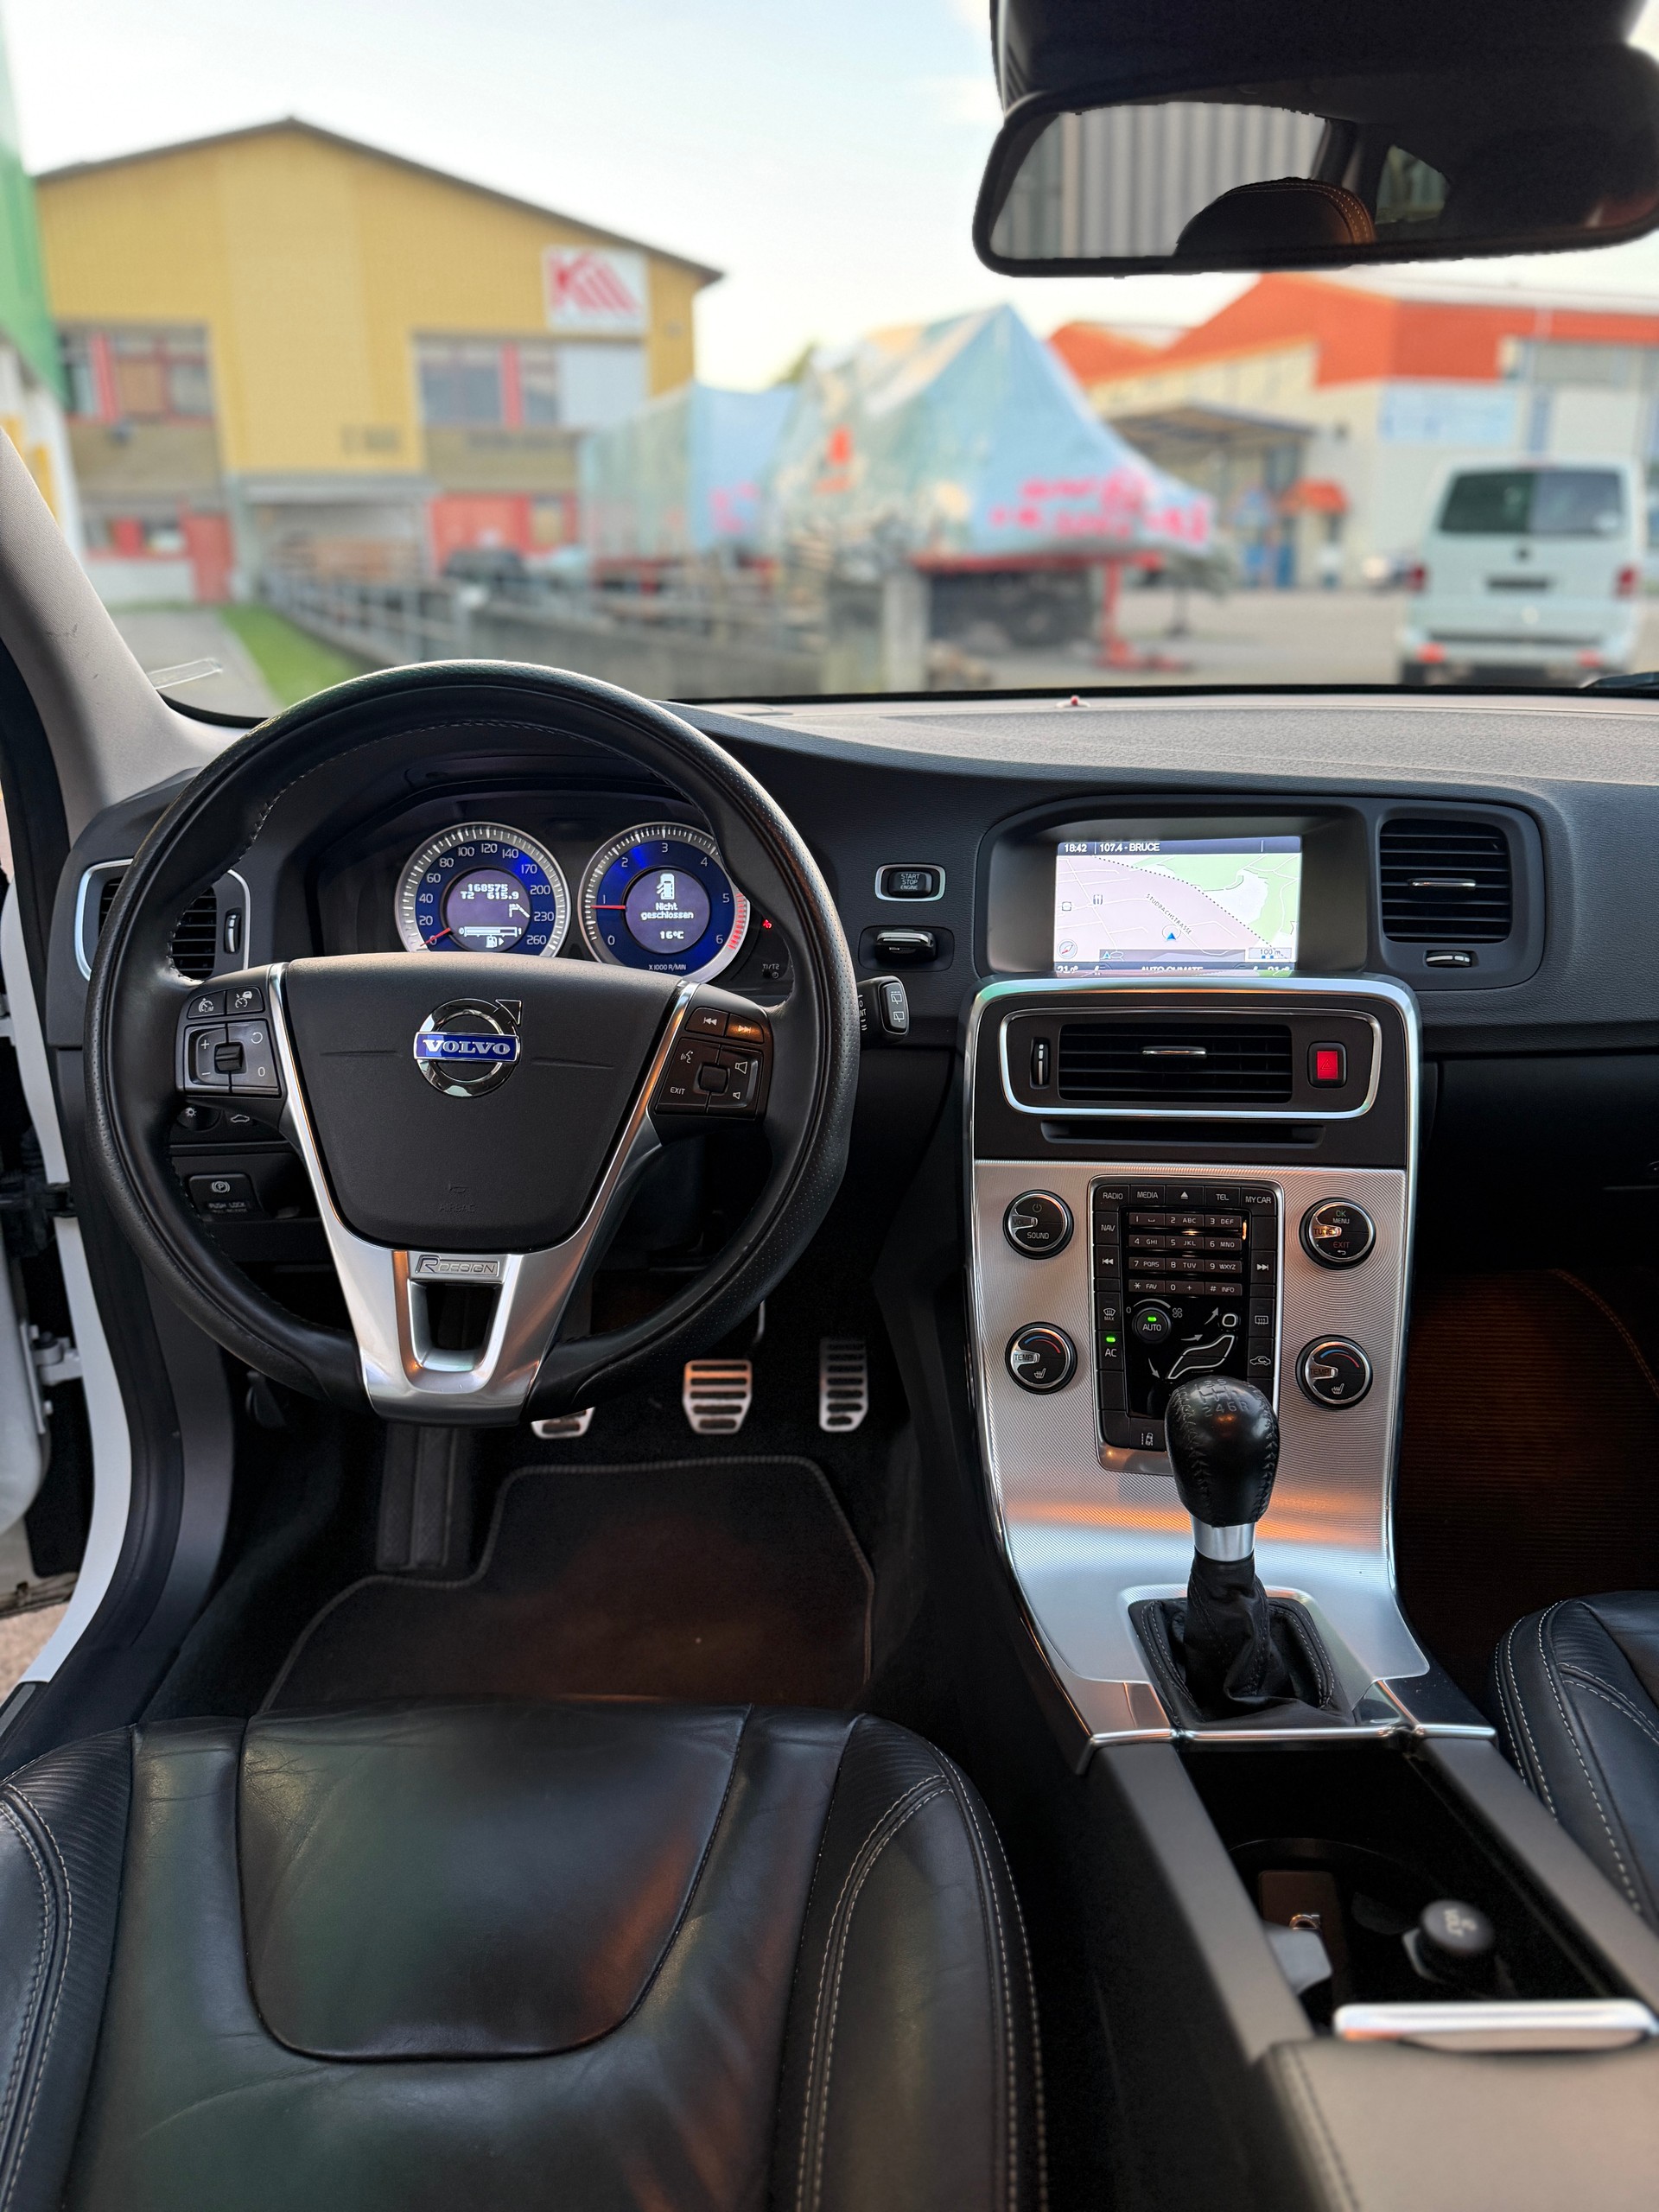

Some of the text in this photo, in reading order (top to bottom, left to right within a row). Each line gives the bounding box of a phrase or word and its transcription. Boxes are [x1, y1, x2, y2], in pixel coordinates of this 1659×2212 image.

[458, 847, 475, 857] 100
[481, 843, 498, 854] 120
[661, 842, 669, 853] 3
[1064, 843, 1088, 853] 18:42
[1099, 843, 1123, 852] 107.4
[1128, 842, 1160, 852] BRUCE
[502, 849, 519, 859] 140
[440, 858, 454, 868] 80
[621, 857, 628, 868] 2
[700, 857, 709, 867] 4
[521, 864, 538, 874] 170
[427, 874, 442, 883] 60
[467, 883, 509, 893] 168575
[530, 885, 551, 895] 200
[419, 893, 434, 904] 40
[461, 891, 519, 899] T2 615.9
[722, 893, 730, 903] 5
[655, 902, 678, 912] Nicht
[419, 915, 433, 925] 20
[534, 912, 555, 922] 230
[640, 911, 695, 920] geschlossen
[429, 935, 437, 945] 0
[526, 935, 547, 945] 260
[607, 935, 615, 946] 0
[715, 934, 723, 944] 6
[423, 1039, 511, 1055] VOLVO
[670, 1086, 686, 1095] EXIT
[1103, 1192, 1123, 1200] RADIO
[1101, 1224, 1116, 1232] NAV
[1027, 1231, 1050, 1240] SOUND
[1104, 1349, 1117, 1357] AC
[1215, 1403, 1225, 1414] 4
[1227, 1401, 1237, 1412] 6
